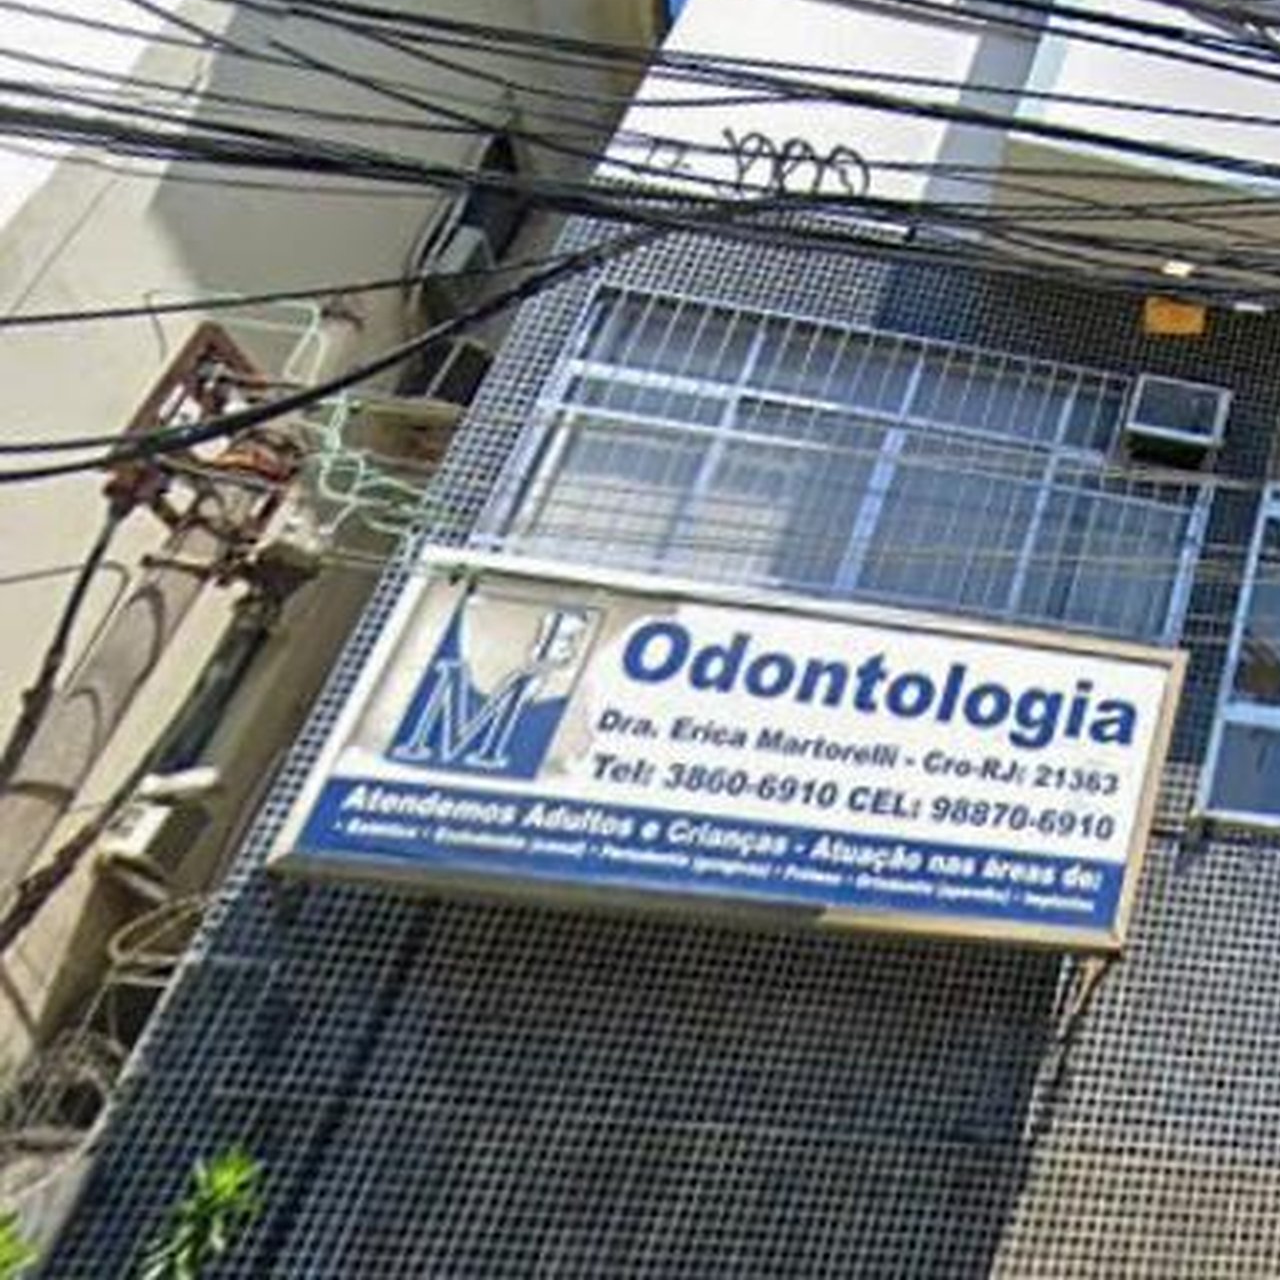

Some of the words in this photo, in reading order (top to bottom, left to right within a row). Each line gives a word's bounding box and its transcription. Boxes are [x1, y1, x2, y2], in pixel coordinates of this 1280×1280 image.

[623, 621, 1137, 749] Odontologia
[598, 708, 658, 738] Dra.
[671, 715, 747, 748] Erica
[755, 727, 899, 768] Martorelli
[340, 784, 517, 823] Atendemos
[521, 802, 632, 837] Adultos
[641, 821, 659, 839] e
[667, 821, 789, 856] Crianças
[809, 835, 922, 873] Atuação
[926, 853, 977, 877] nas
[593, 752, 655, 786] Tel:
[849, 785, 922, 819] CEL:
[931, 796, 1115, 841] 98870-6910
